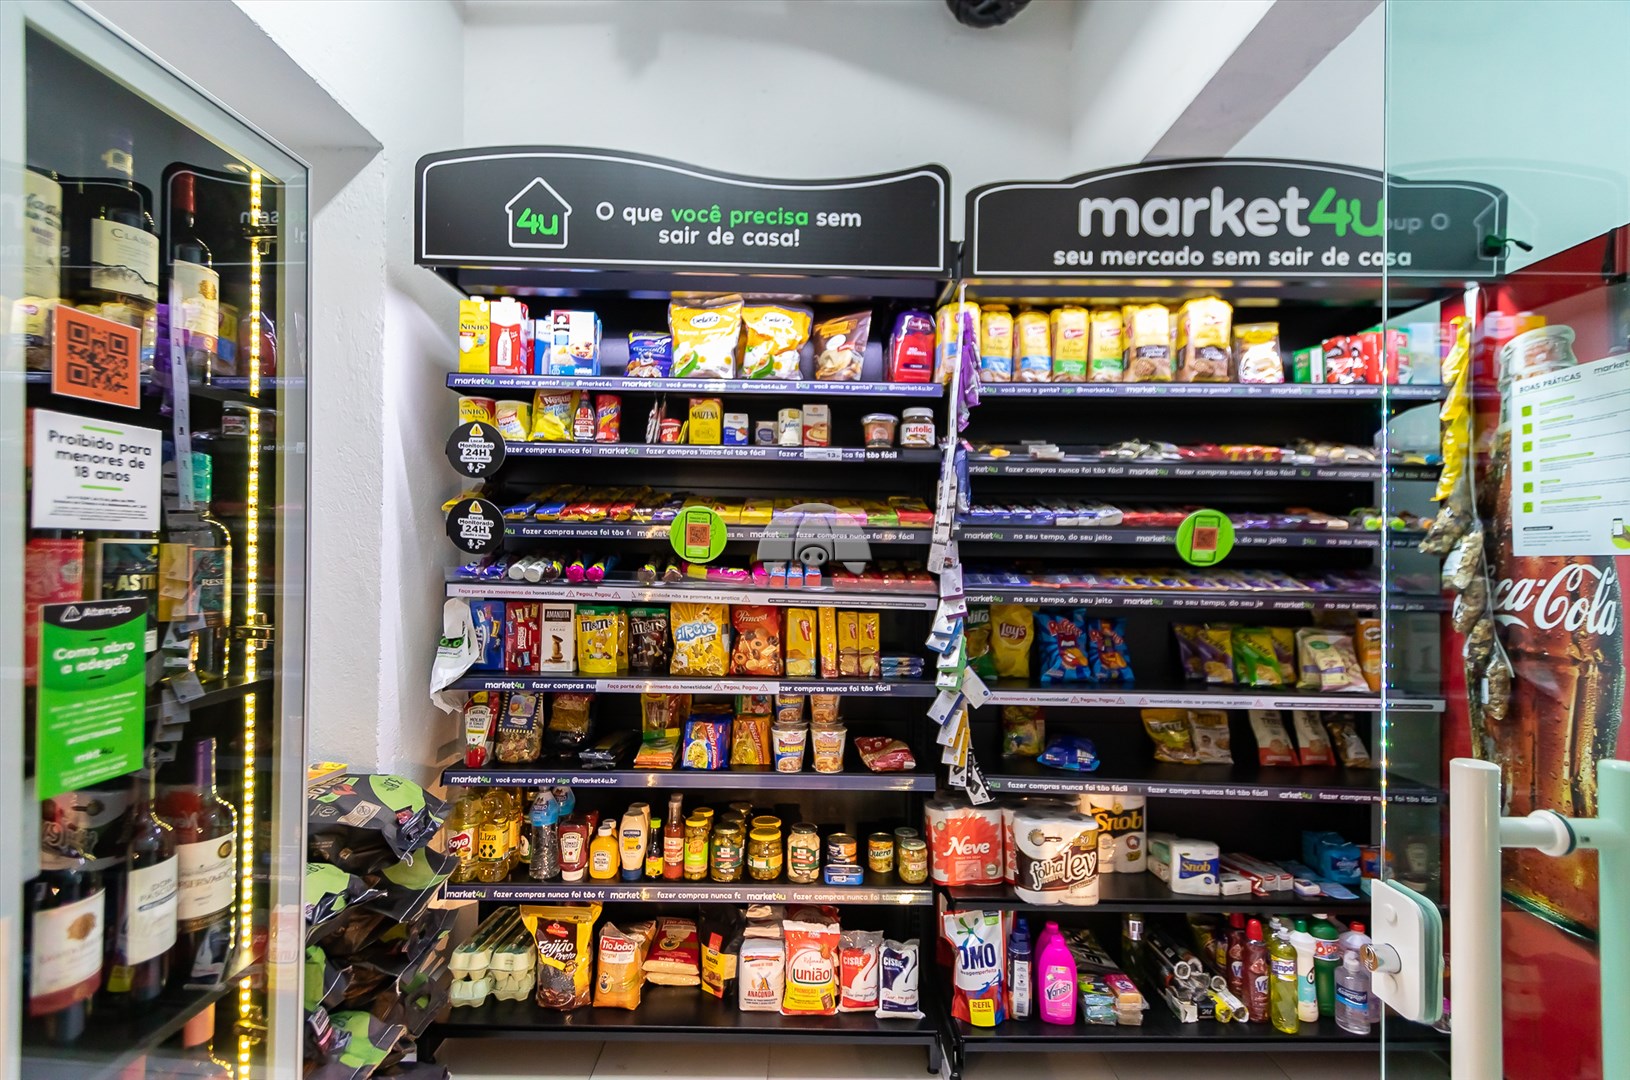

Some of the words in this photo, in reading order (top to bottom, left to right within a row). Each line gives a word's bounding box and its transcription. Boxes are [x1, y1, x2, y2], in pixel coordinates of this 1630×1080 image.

[595, 202, 614, 221] O
[622, 207, 663, 226] que
[670, 204, 721, 225] você
[729, 206, 809, 229] precisa
[815, 211, 862, 228] sem
[1077, 186, 1384, 238] market4u
[516, 207, 559, 236] 4u
[658, 227, 700, 245] sair
[707, 227, 734, 246] de
[741, 228, 800, 248] casa!
[1052, 250, 1093, 267] seu
[1100, 247, 1204, 267] mercado
[1212, 250, 1260, 267] sem
[1268, 247, 1313, 267] sair
[1321, 247, 1350, 267] de
[1358, 250, 1412, 267] casa
[454, 377, 495, 385] market4u
[538, 379, 559, 388] gente?
[814, 382, 828, 390] você
[851, 383, 873, 391] gente?
[1520, 383, 1540, 394] BOAS
[1543, 372, 1581, 387] PRÁTICAS
[1001, 386, 1016, 394] você
[1039, 386, 1060, 395] gente?
[691, 411, 718, 420] MAIZENA
[905, 426, 933, 434] nutella
[48, 429, 114, 450] Proibido
[119, 443, 152, 456] para
[506, 445, 522, 454] fazer
[523, 447, 556, 455] compras
[582, 446, 592, 454] foi
[599, 447, 639, 455] market4u
[664, 449, 698, 457] compras
[881, 451, 898, 459] fácil
[55, 450, 124, 467] menores
[129, 457, 145, 469] de
[74, 466, 89, 478] 18
[95, 470, 130, 482] anos
[1005, 466, 1024, 474] fazer
[1081, 466, 1092, 474] foi
[1108, 466, 1124, 474] fácil
[465, 525, 486, 533] 24H
[522, 528, 541, 536] fazer
[600, 528, 610, 536] foi
[817, 532, 847, 540] compras
[872, 532, 883, 540] foi
[964, 532, 1004, 540] market4u
[1040, 534, 1066, 542] tempo,
[1095, 534, 1113, 542] jeito
[1040, 596, 1066, 605] tempo,
[1095, 597, 1113, 605] jeito
[1200, 599, 1228, 608] tempo,
[1493, 563, 1617, 635] ca-Cola
[81, 605, 131, 617] Atenção
[1001, 625, 1026, 640] Lay's
[54, 646, 99, 661] Como
[102, 641, 135, 654] abro
[60, 664, 73, 674] a
[76, 654, 129, 672] adega?
[532, 682, 551, 690] fazer
[794, 685, 824, 694] compras
[451, 776, 491, 784] market4u
[495, 776, 511, 784] você
[533, 777, 556, 786] gente?
[571, 777, 617, 785] @market4u.br
[1029, 783, 1060, 791] compras
[1111, 784, 1128, 792] fácil
[1147, 786, 1166, 794] fazer
[1095, 811, 1142, 832] Snob
[448, 838, 469, 850] Soya
[943, 836, 990, 857] Neve
[1030, 859, 1062, 891] folha
[1062, 849, 1097, 882] lev
[1182, 861, 1210, 872] Snob
[446, 890, 486, 898] market4u
[493, 890, 512, 898] fazer
[571, 890, 581, 898] foi
[747, 892, 786, 901] market4u
[602, 941, 613, 950] Tio
[613, 941, 634, 951] João
[796, 968, 830, 982] união
[1046, 983, 1071, 1000] Vanish
